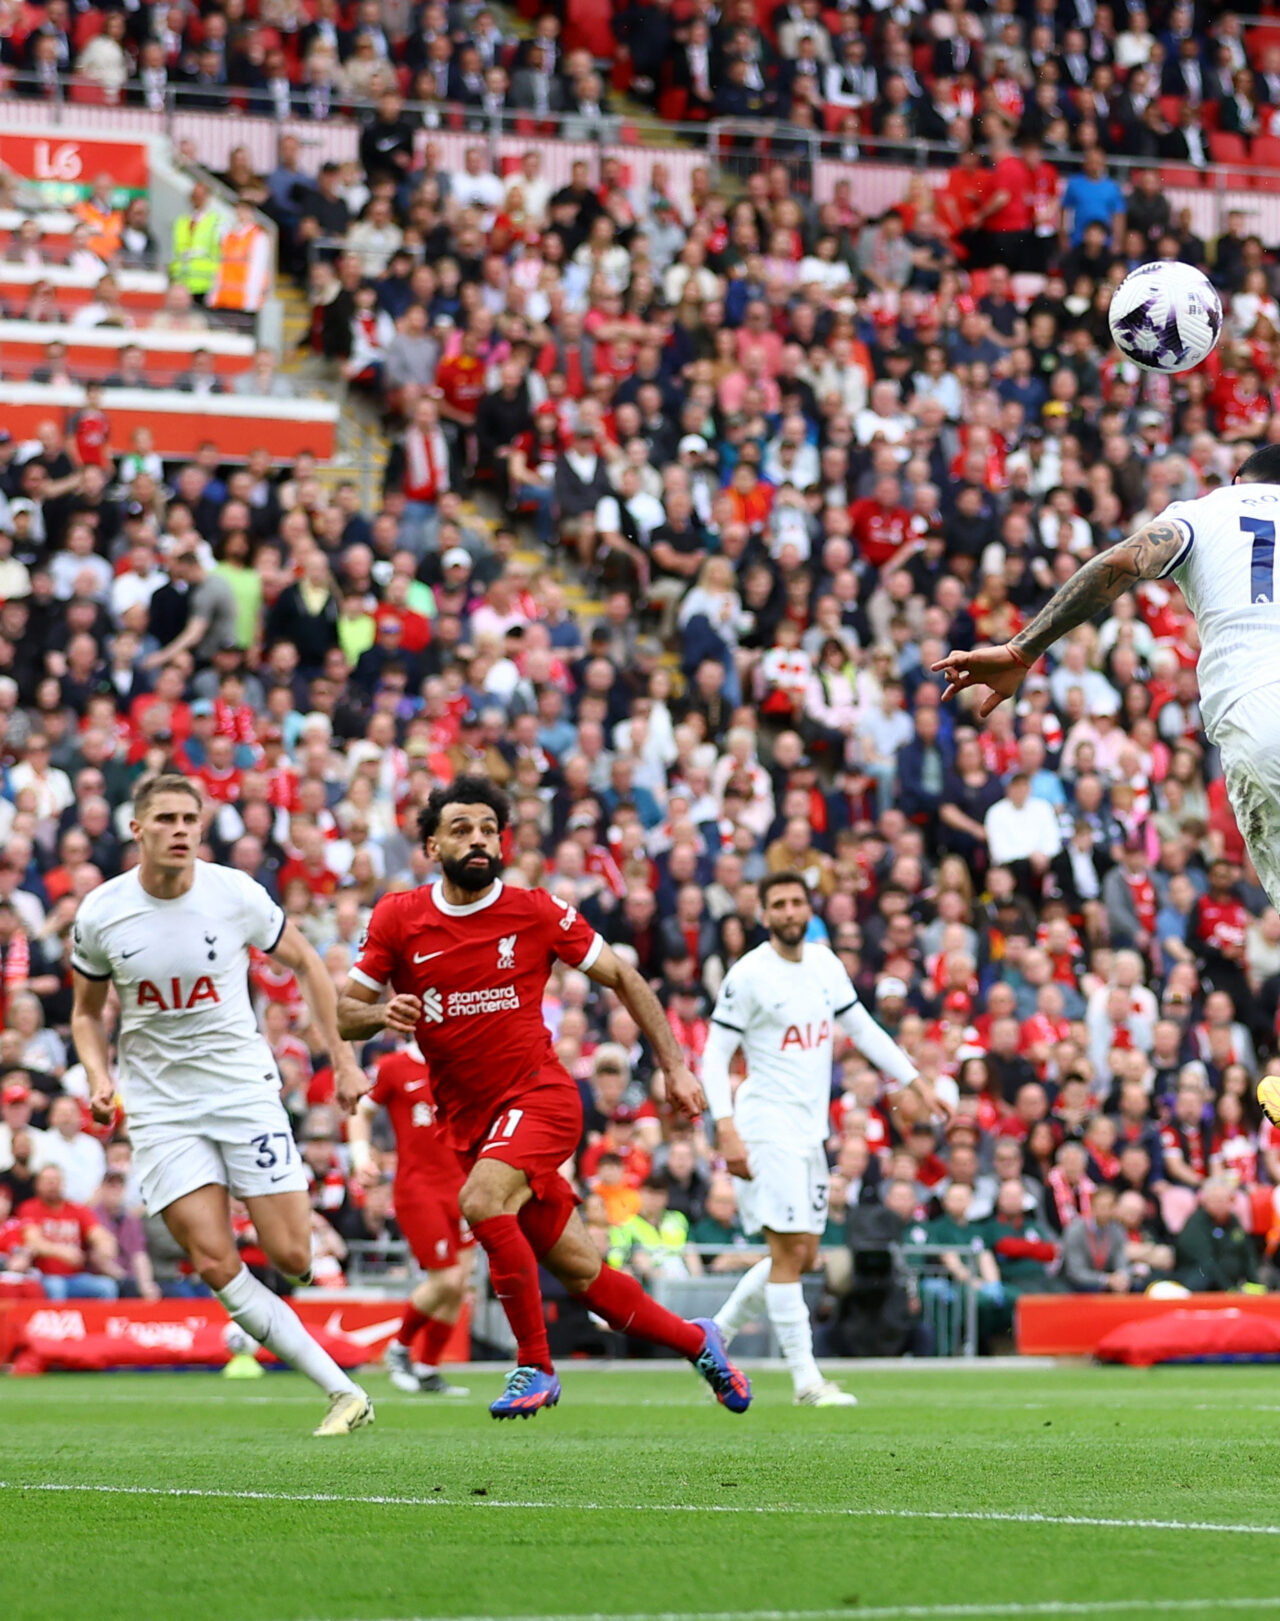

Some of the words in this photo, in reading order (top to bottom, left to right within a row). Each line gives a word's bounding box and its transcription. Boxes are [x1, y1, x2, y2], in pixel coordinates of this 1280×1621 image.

[34, 140, 82, 180] L6
[137, 976, 221, 1011] AIA
[447, 984, 515, 1005] standard
[447, 995, 520, 1016] chartered
[780, 1020, 829, 1051] AIA
[251, 1132, 291, 1168] 37
